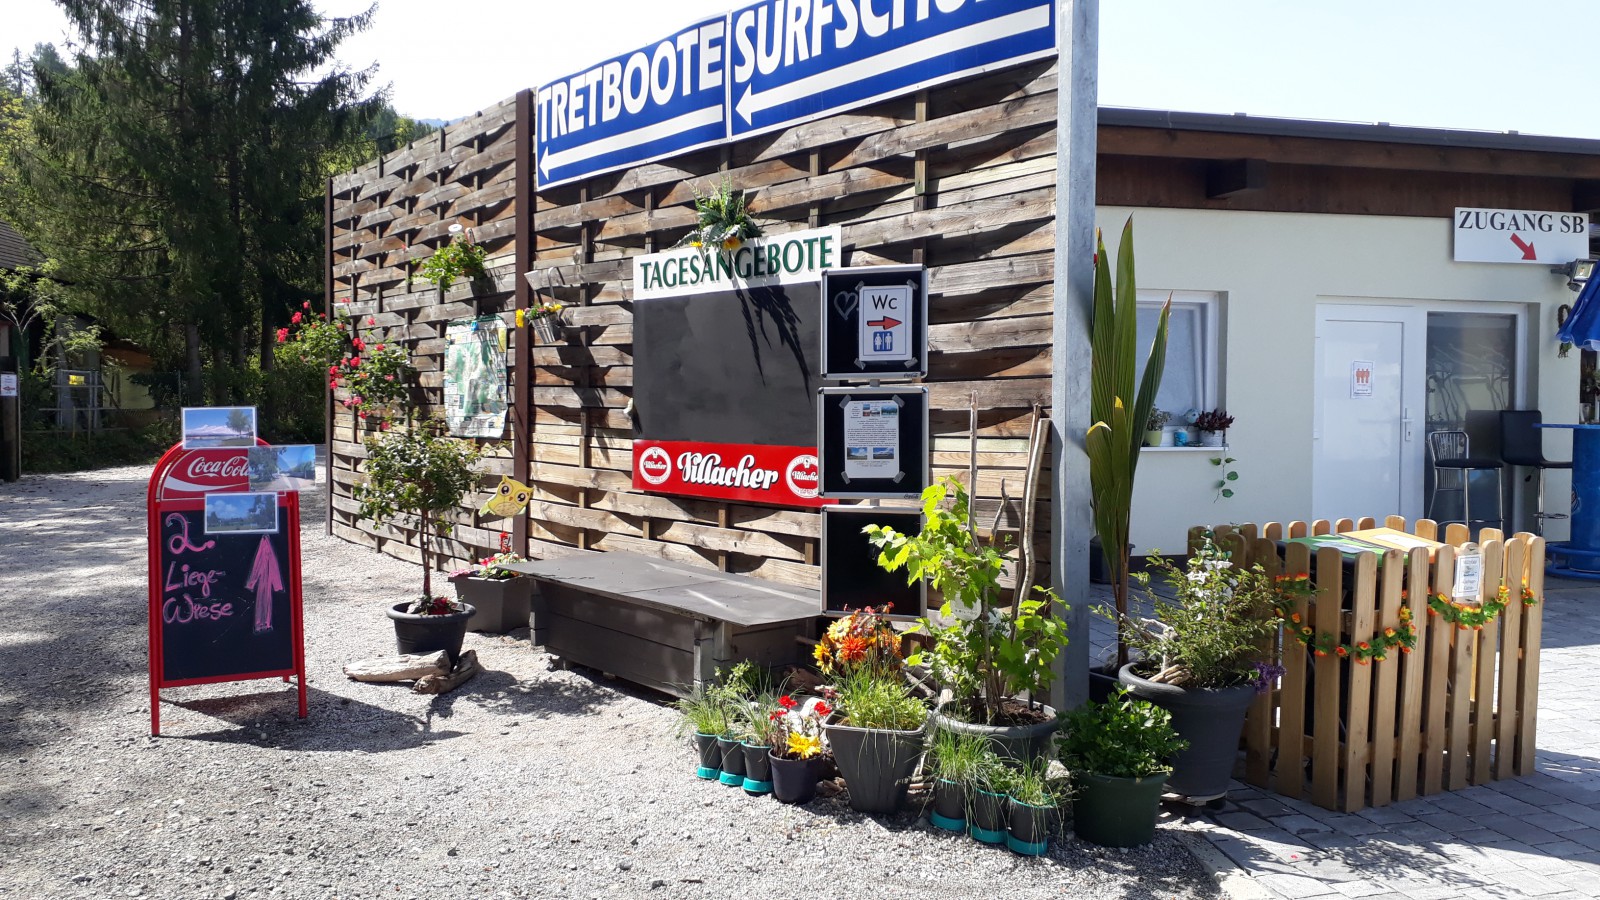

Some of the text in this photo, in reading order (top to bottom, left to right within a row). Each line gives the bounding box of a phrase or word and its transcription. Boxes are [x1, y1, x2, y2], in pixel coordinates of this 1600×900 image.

[734, 0, 986, 83] SURFSC
[537, 20, 725, 143] TRETBOOTE
[1458, 210, 1585, 234] ZUGANG SB
[639, 235, 834, 290] TAGESANGEBOTE
[676, 451, 779, 490] Villacher
[164, 561, 226, 598] Liege-
[162, 593, 234, 624] Wiese
